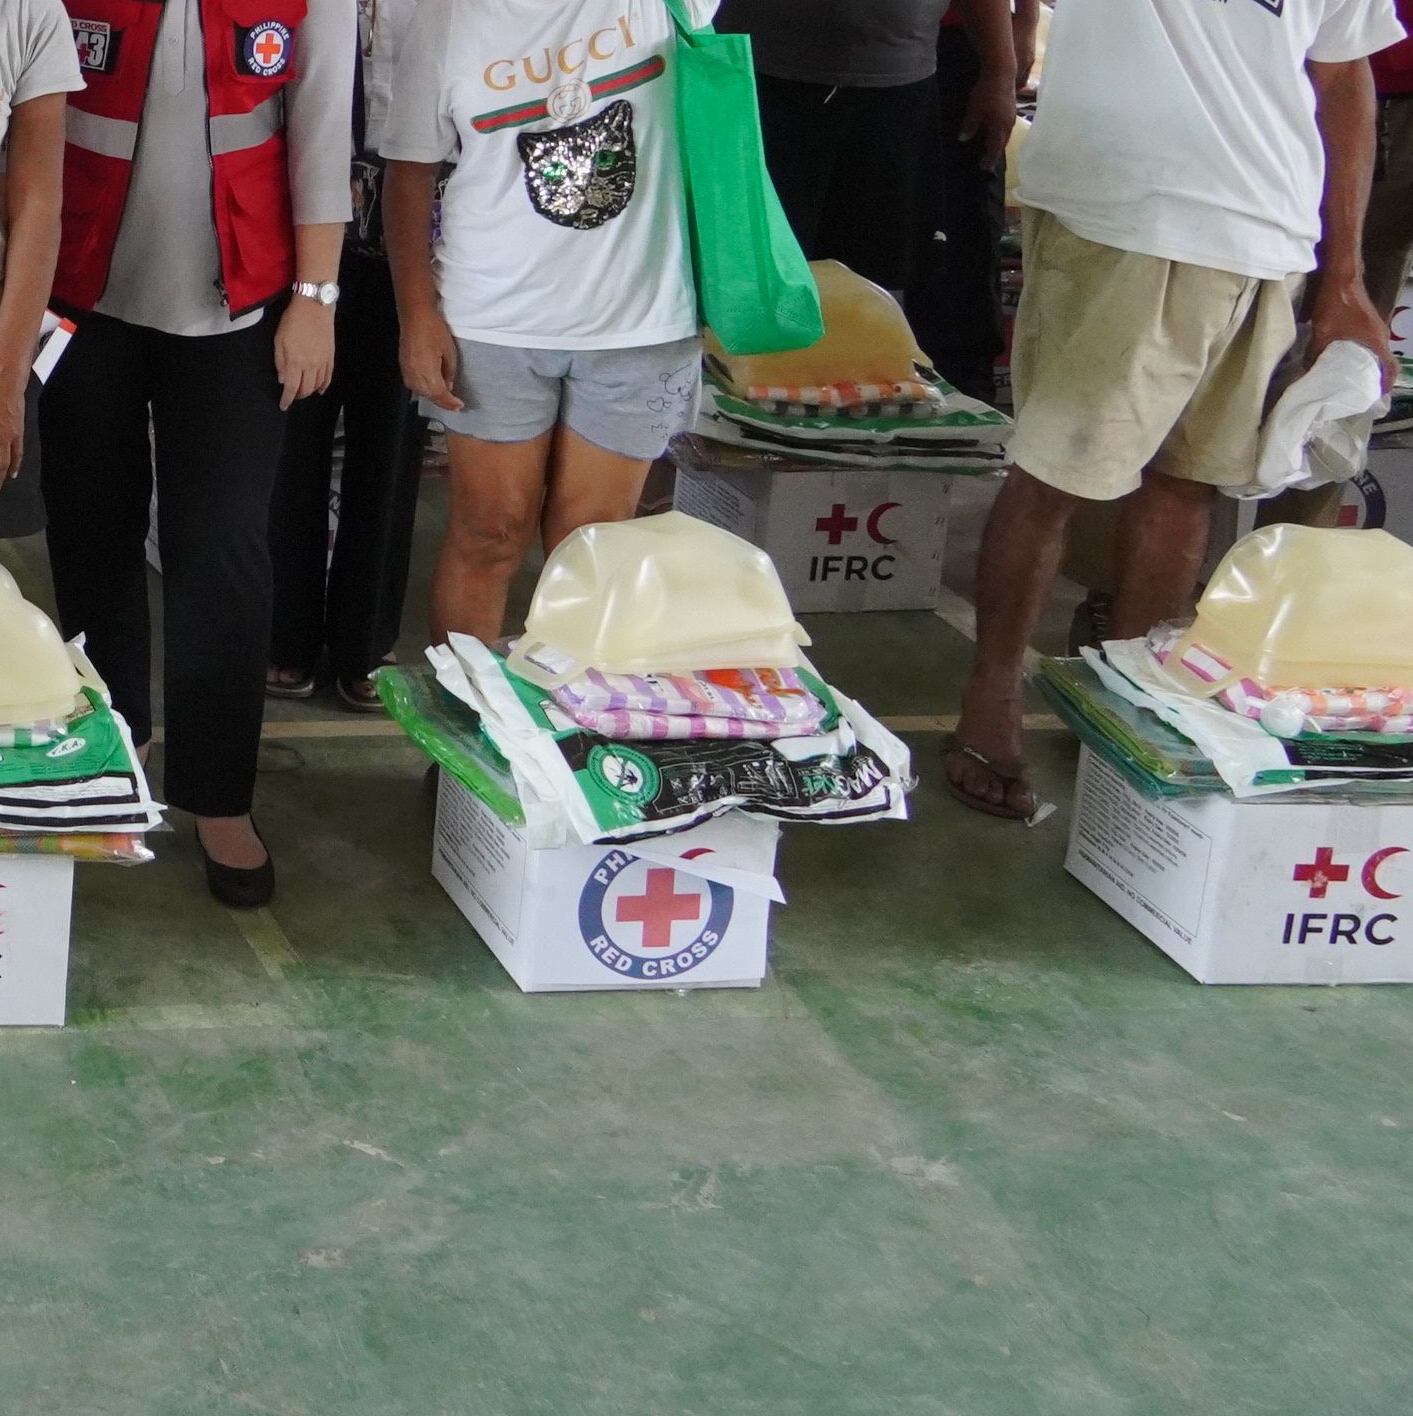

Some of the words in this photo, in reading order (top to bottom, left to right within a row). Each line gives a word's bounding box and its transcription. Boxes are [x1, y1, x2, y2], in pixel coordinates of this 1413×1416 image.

[79, 22, 108, 33] CROSS
[249, 21, 291, 42] PHILIPPINE
[75, 31, 107, 67] 43
[483, 15, 636, 92] GUCCI
[247, 57, 261, 75] RED
[263, 58, 287, 77] CROSS
[809, 554, 896, 582] IFRC
[1282, 912, 1399, 946] IFRC
[589, 933, 633, 974] RED
[642, 928, 720, 978] CROSS
